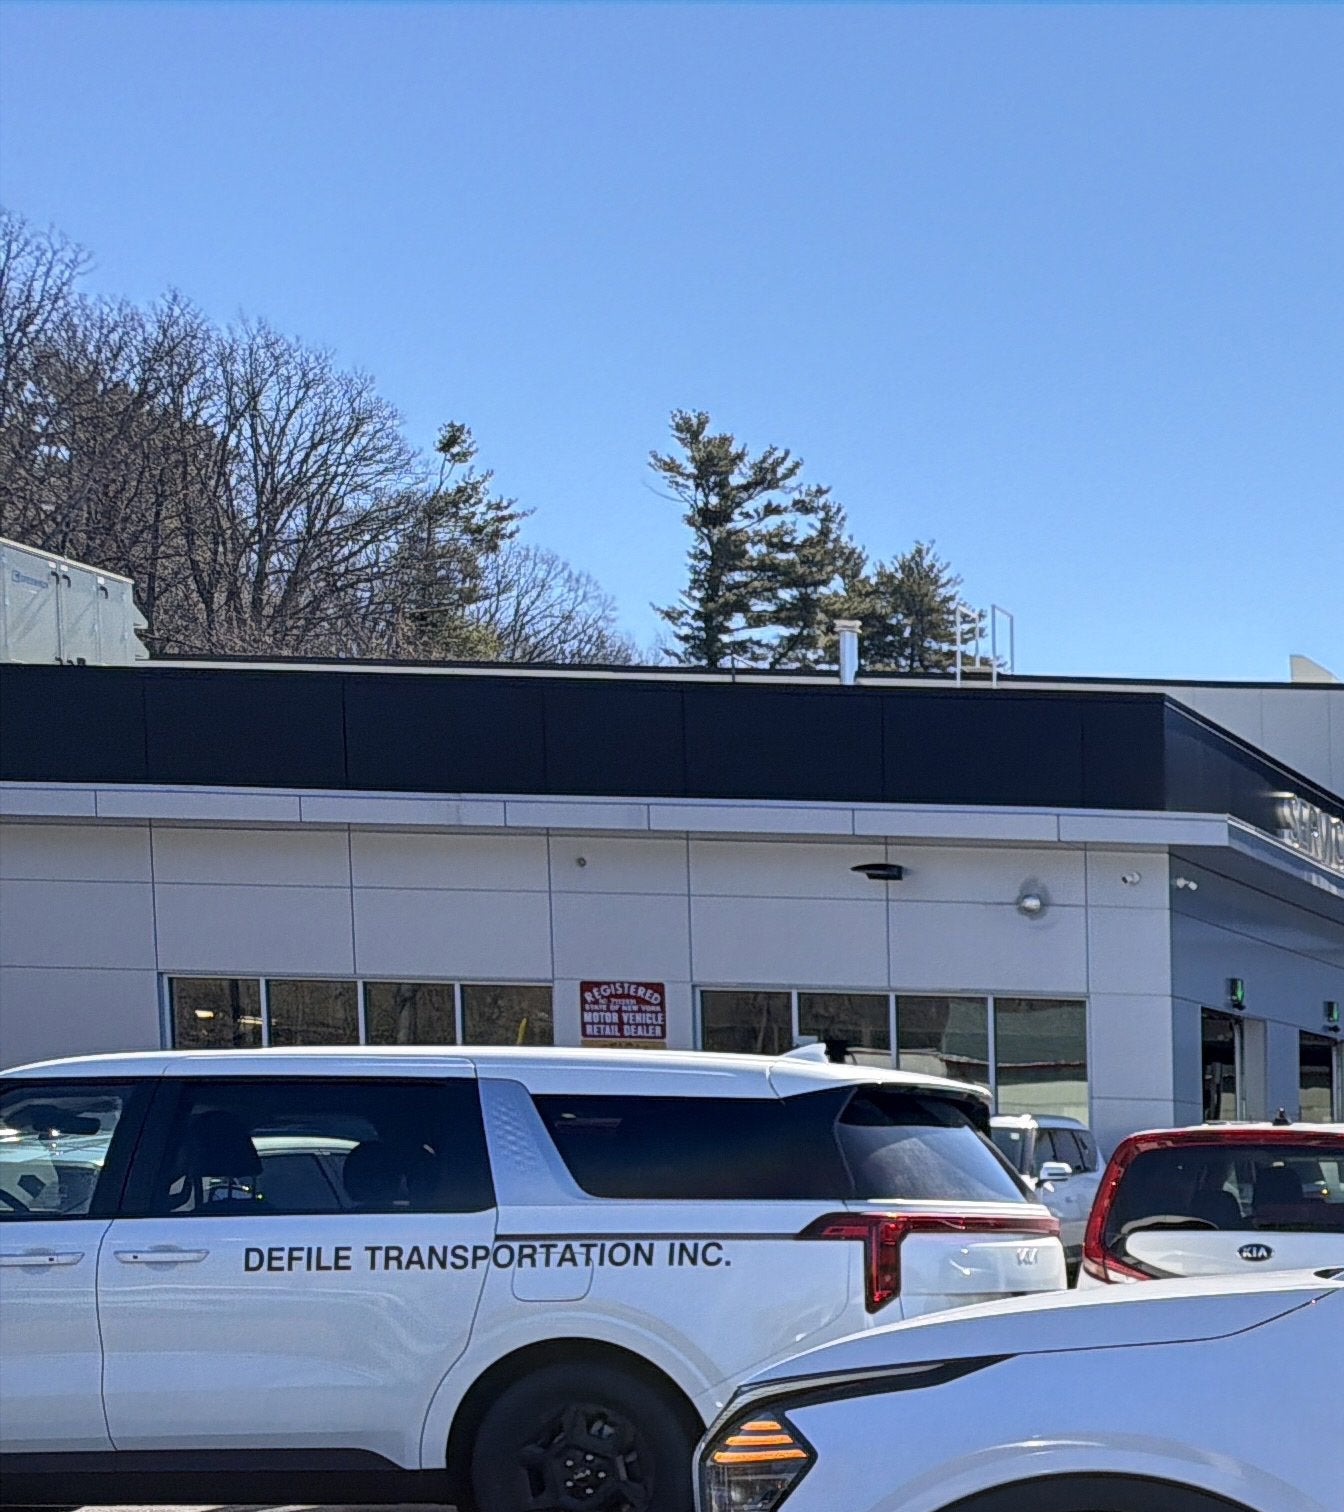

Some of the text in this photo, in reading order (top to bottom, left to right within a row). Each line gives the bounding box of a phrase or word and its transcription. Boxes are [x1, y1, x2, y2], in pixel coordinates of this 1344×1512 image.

[584, 983, 662, 1005] REGISTERED
[584, 1003, 607, 1011] STATE
[609, 1003, 621, 1011] OF
[621, 1004, 639, 1012] NEW
[583, 1011, 665, 1025] MOTOR VEHICLE
[585, 1024, 663, 1038] RETAIL DEALER
[243, 1241, 732, 1273] DEFILE TRANSPORTATION INC.
[1241, 1246, 1268, 1258] KIA
